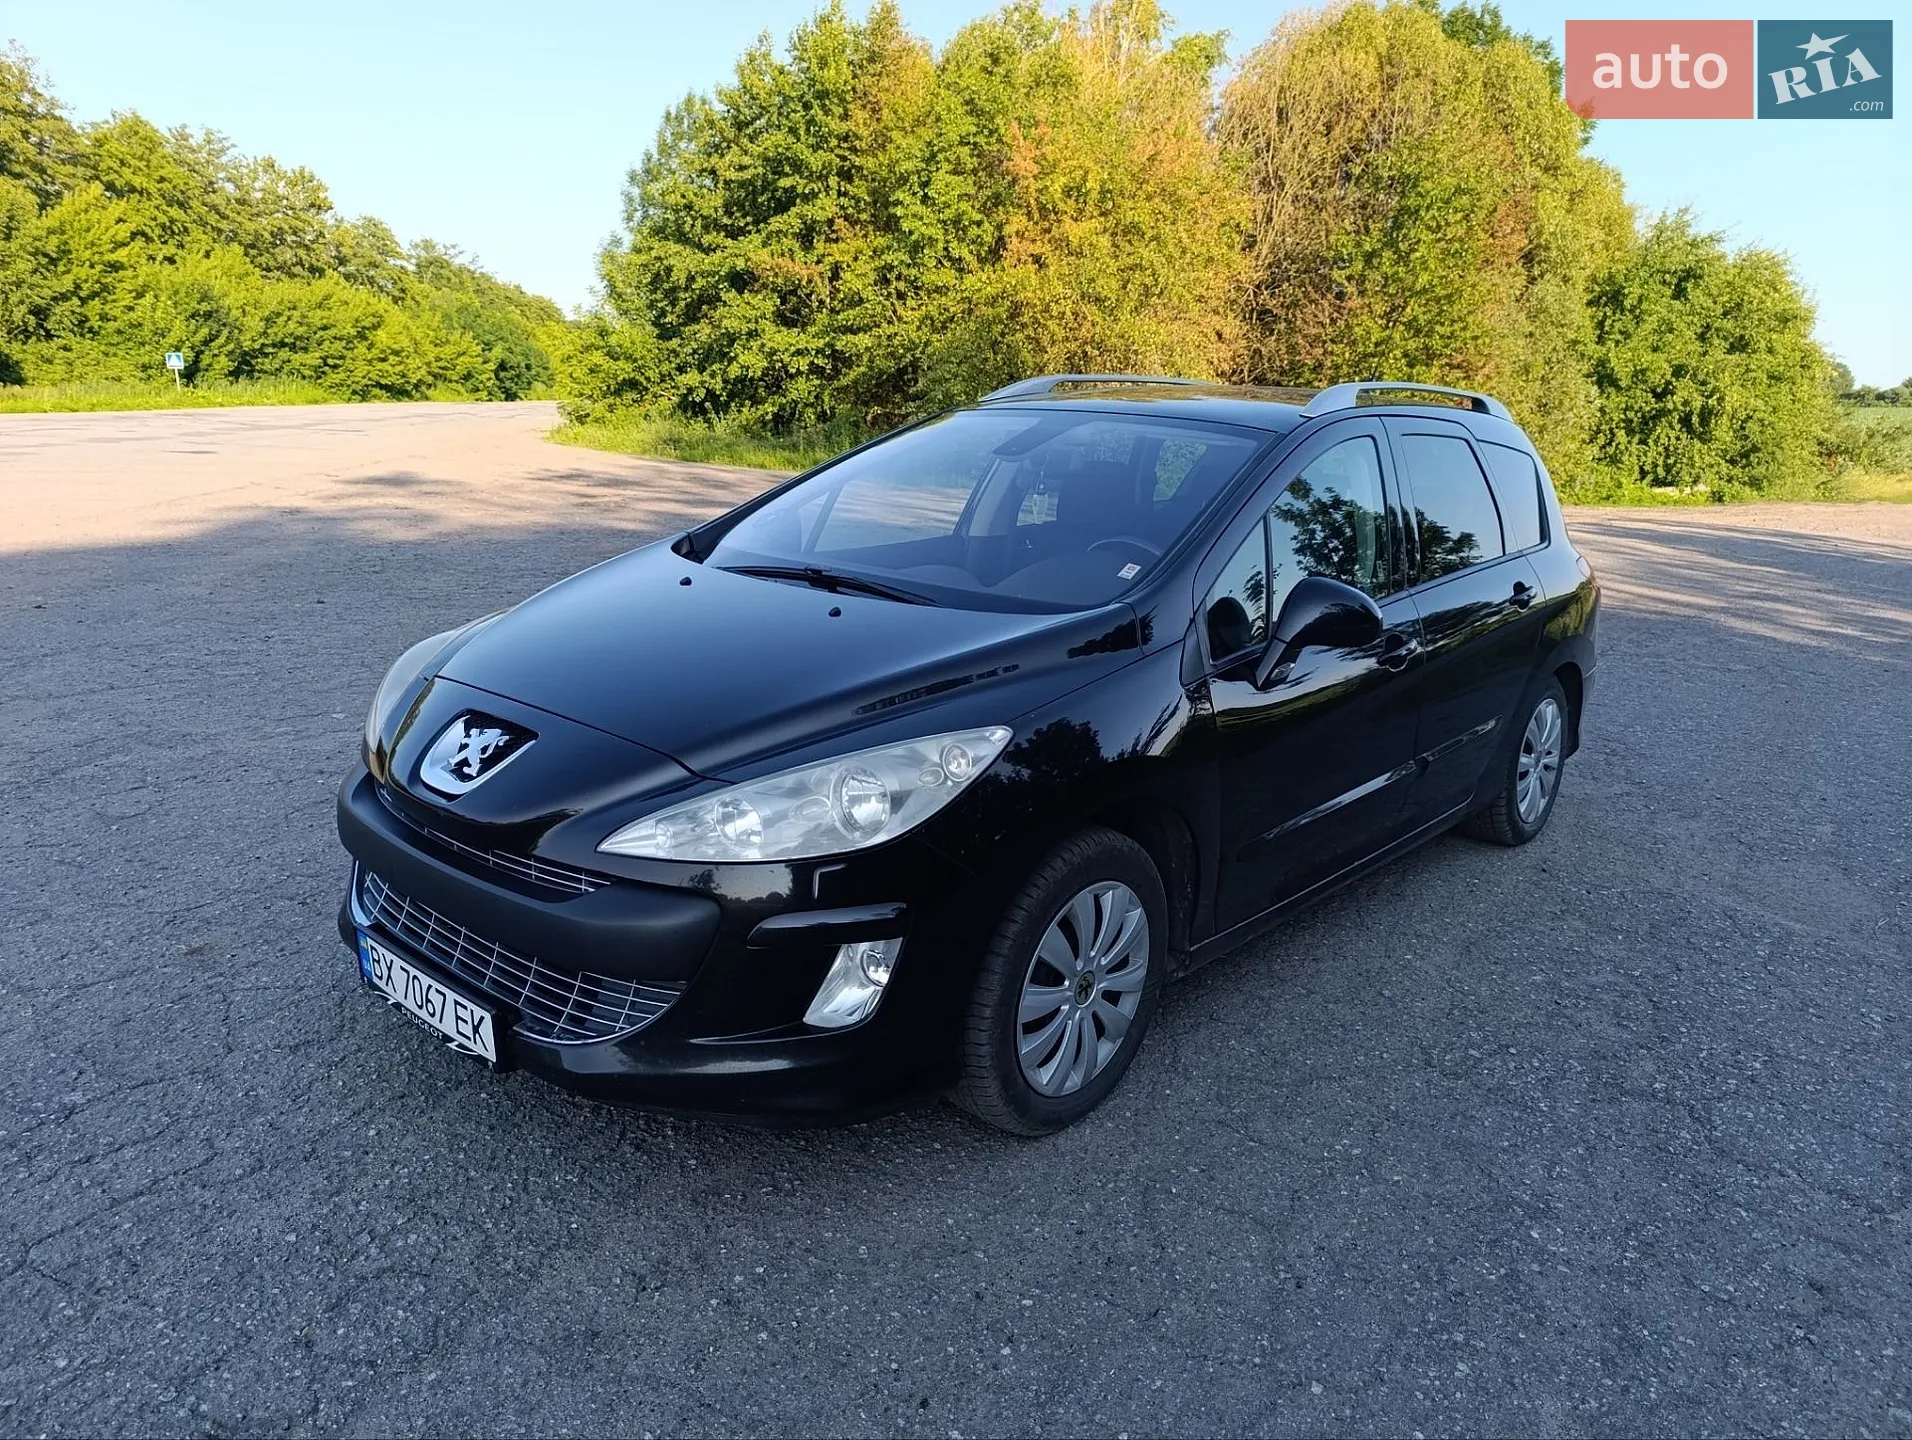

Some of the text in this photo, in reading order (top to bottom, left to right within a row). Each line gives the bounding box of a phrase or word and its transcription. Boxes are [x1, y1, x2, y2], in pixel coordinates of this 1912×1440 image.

[370, 943, 489, 1053] BX 7067 EK
[401, 1006, 444, 1039] PEUGEOT
